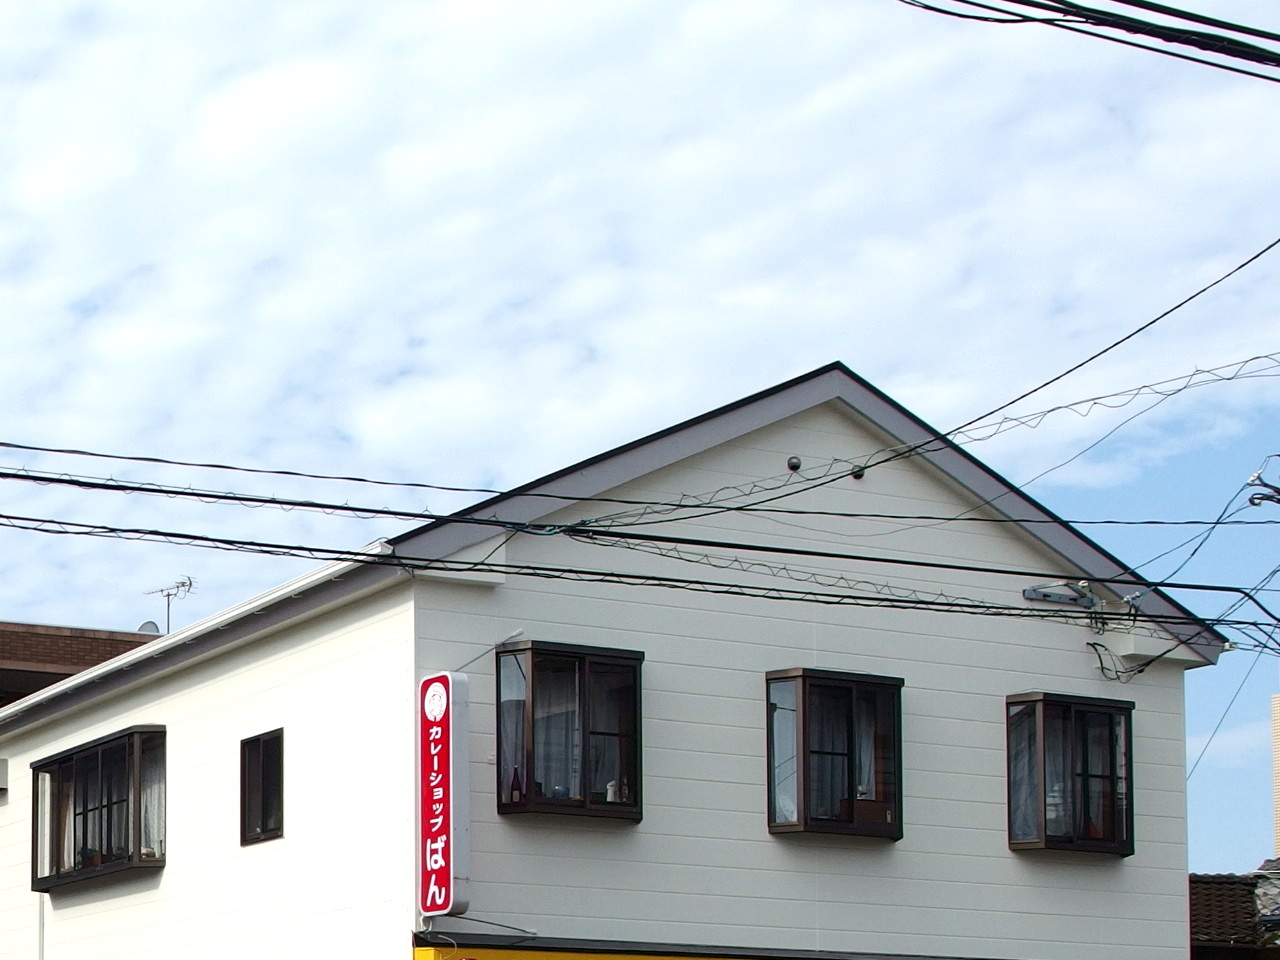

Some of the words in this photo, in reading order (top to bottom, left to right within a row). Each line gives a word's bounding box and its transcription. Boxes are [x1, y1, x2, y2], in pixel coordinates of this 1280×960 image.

[426, 725, 447, 908] カレーショップばん
